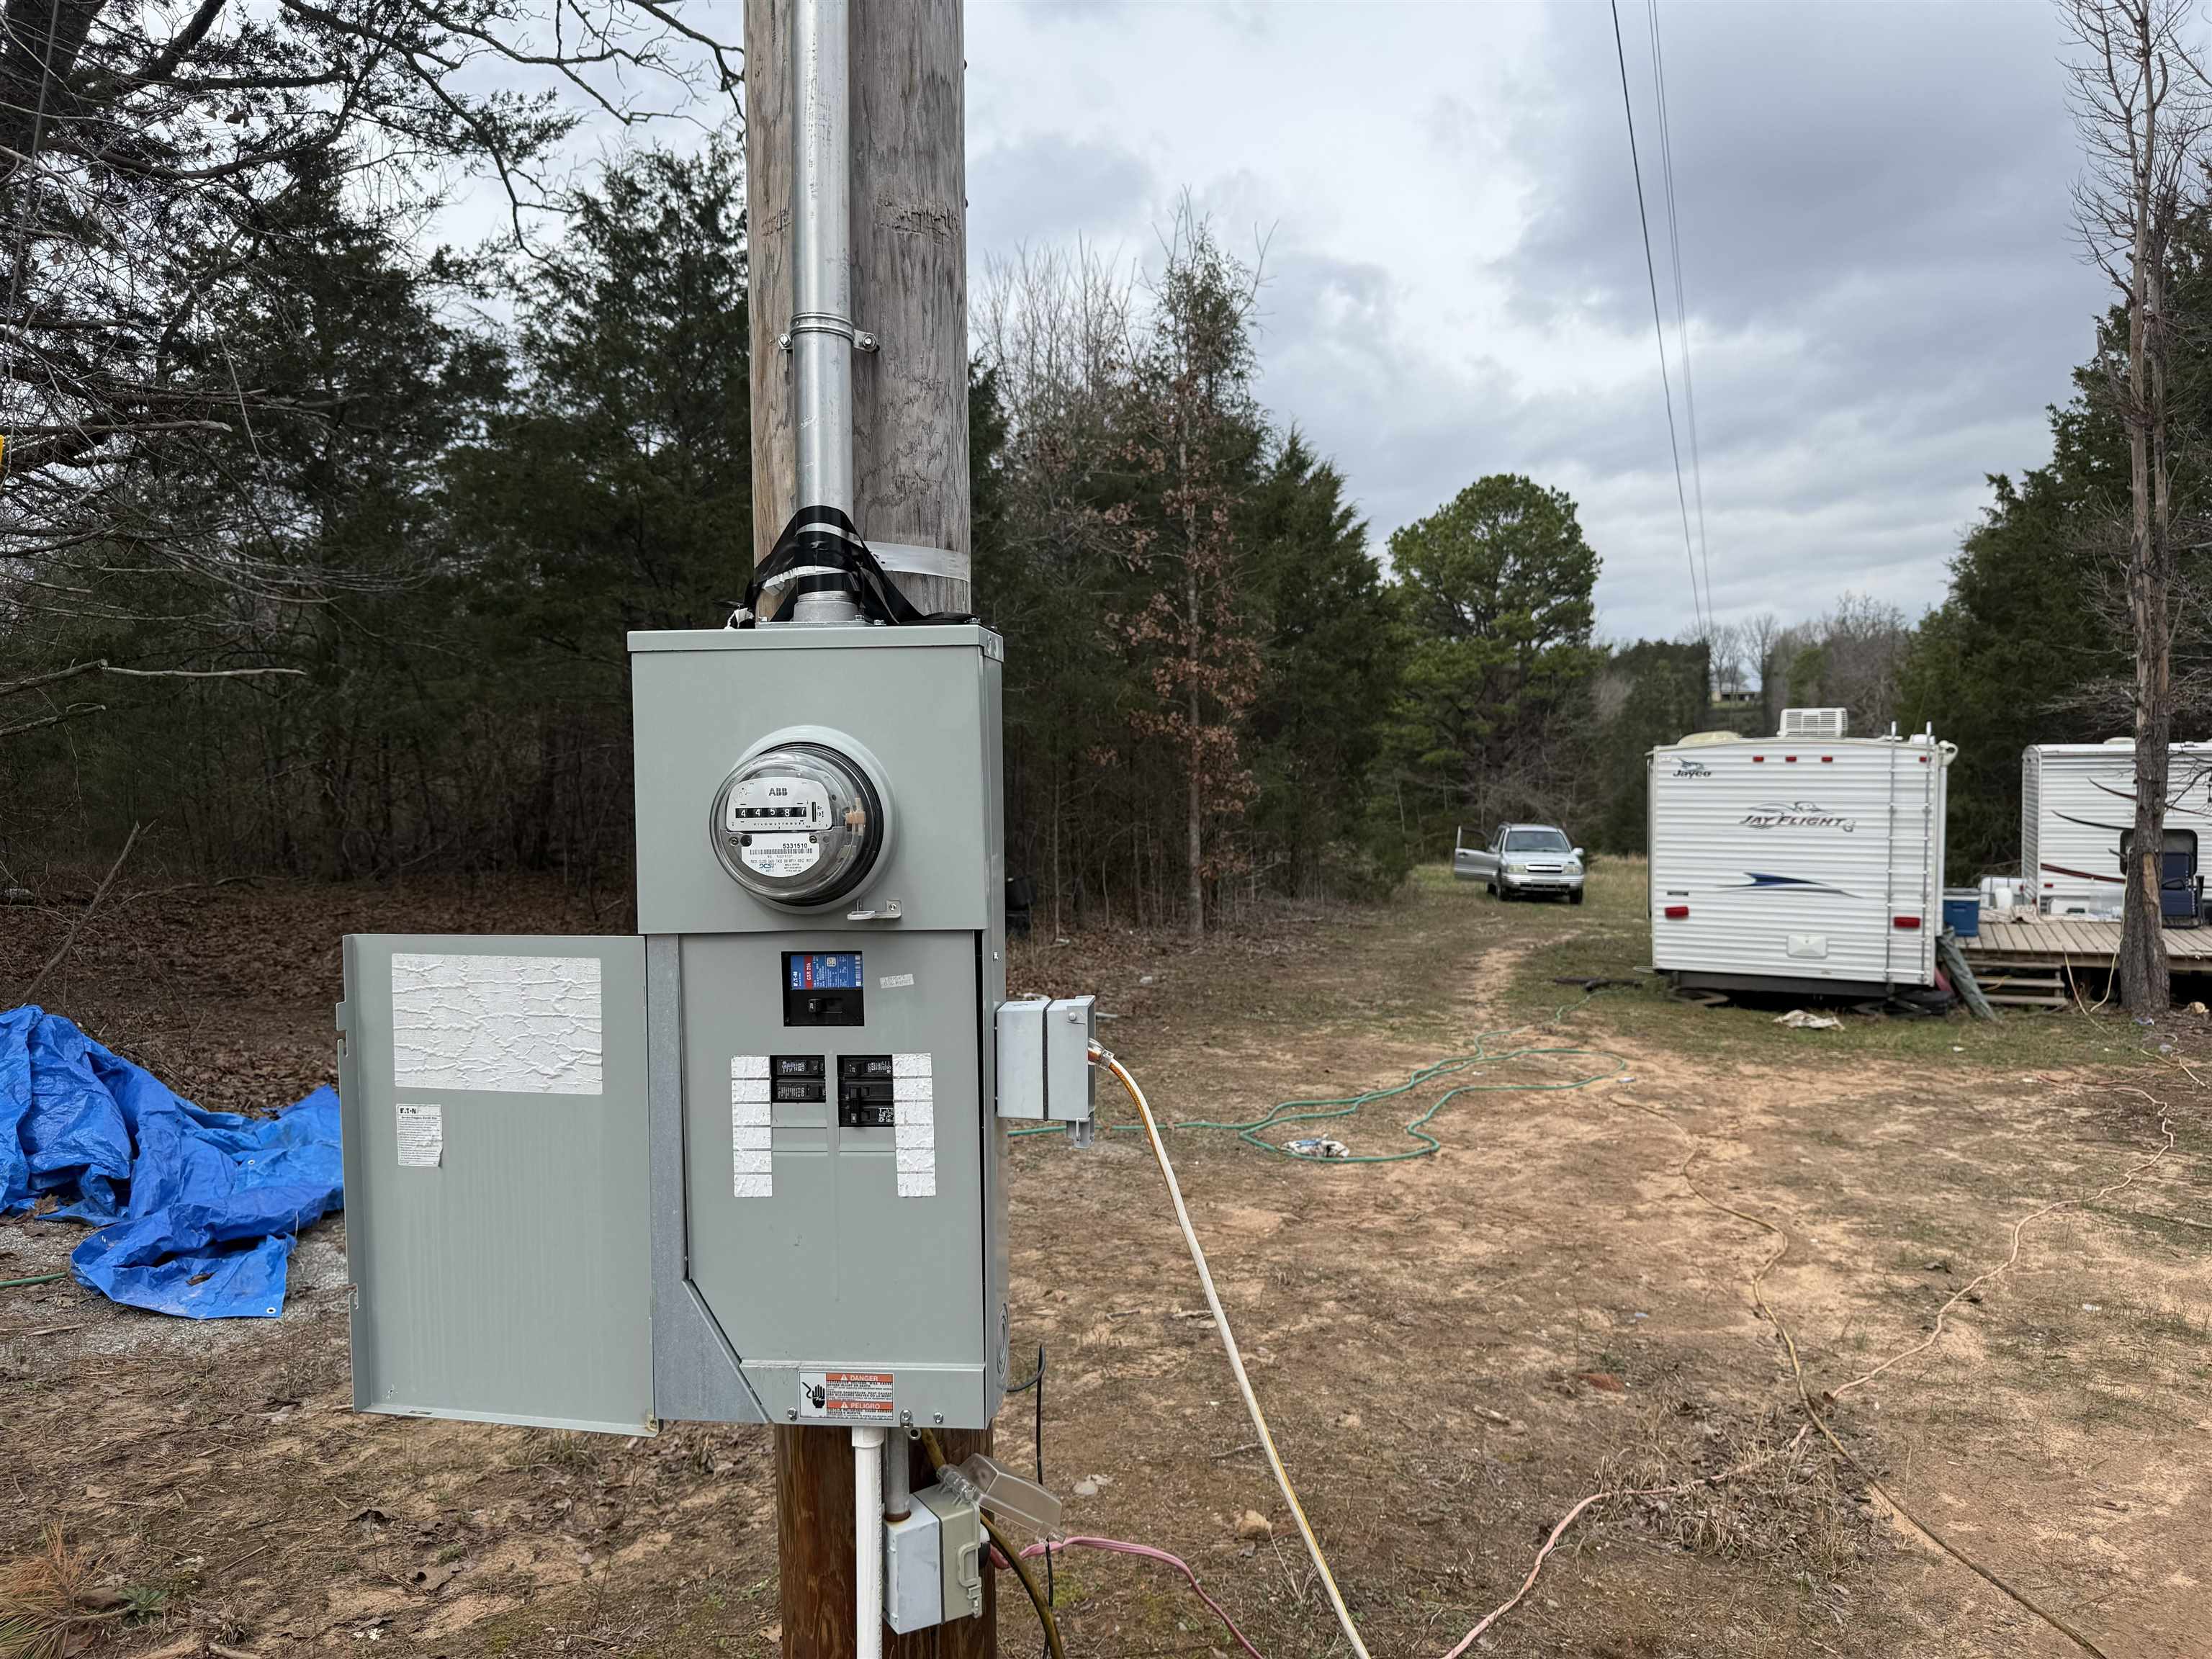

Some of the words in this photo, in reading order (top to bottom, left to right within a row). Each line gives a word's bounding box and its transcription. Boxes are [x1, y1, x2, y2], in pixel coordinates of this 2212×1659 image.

[1673, 770, 1712, 779] Jayco
[768, 788, 788, 796] ABB
[1739, 815, 1776, 825] JAY
[1776, 815, 1848, 827] FLIGHT
